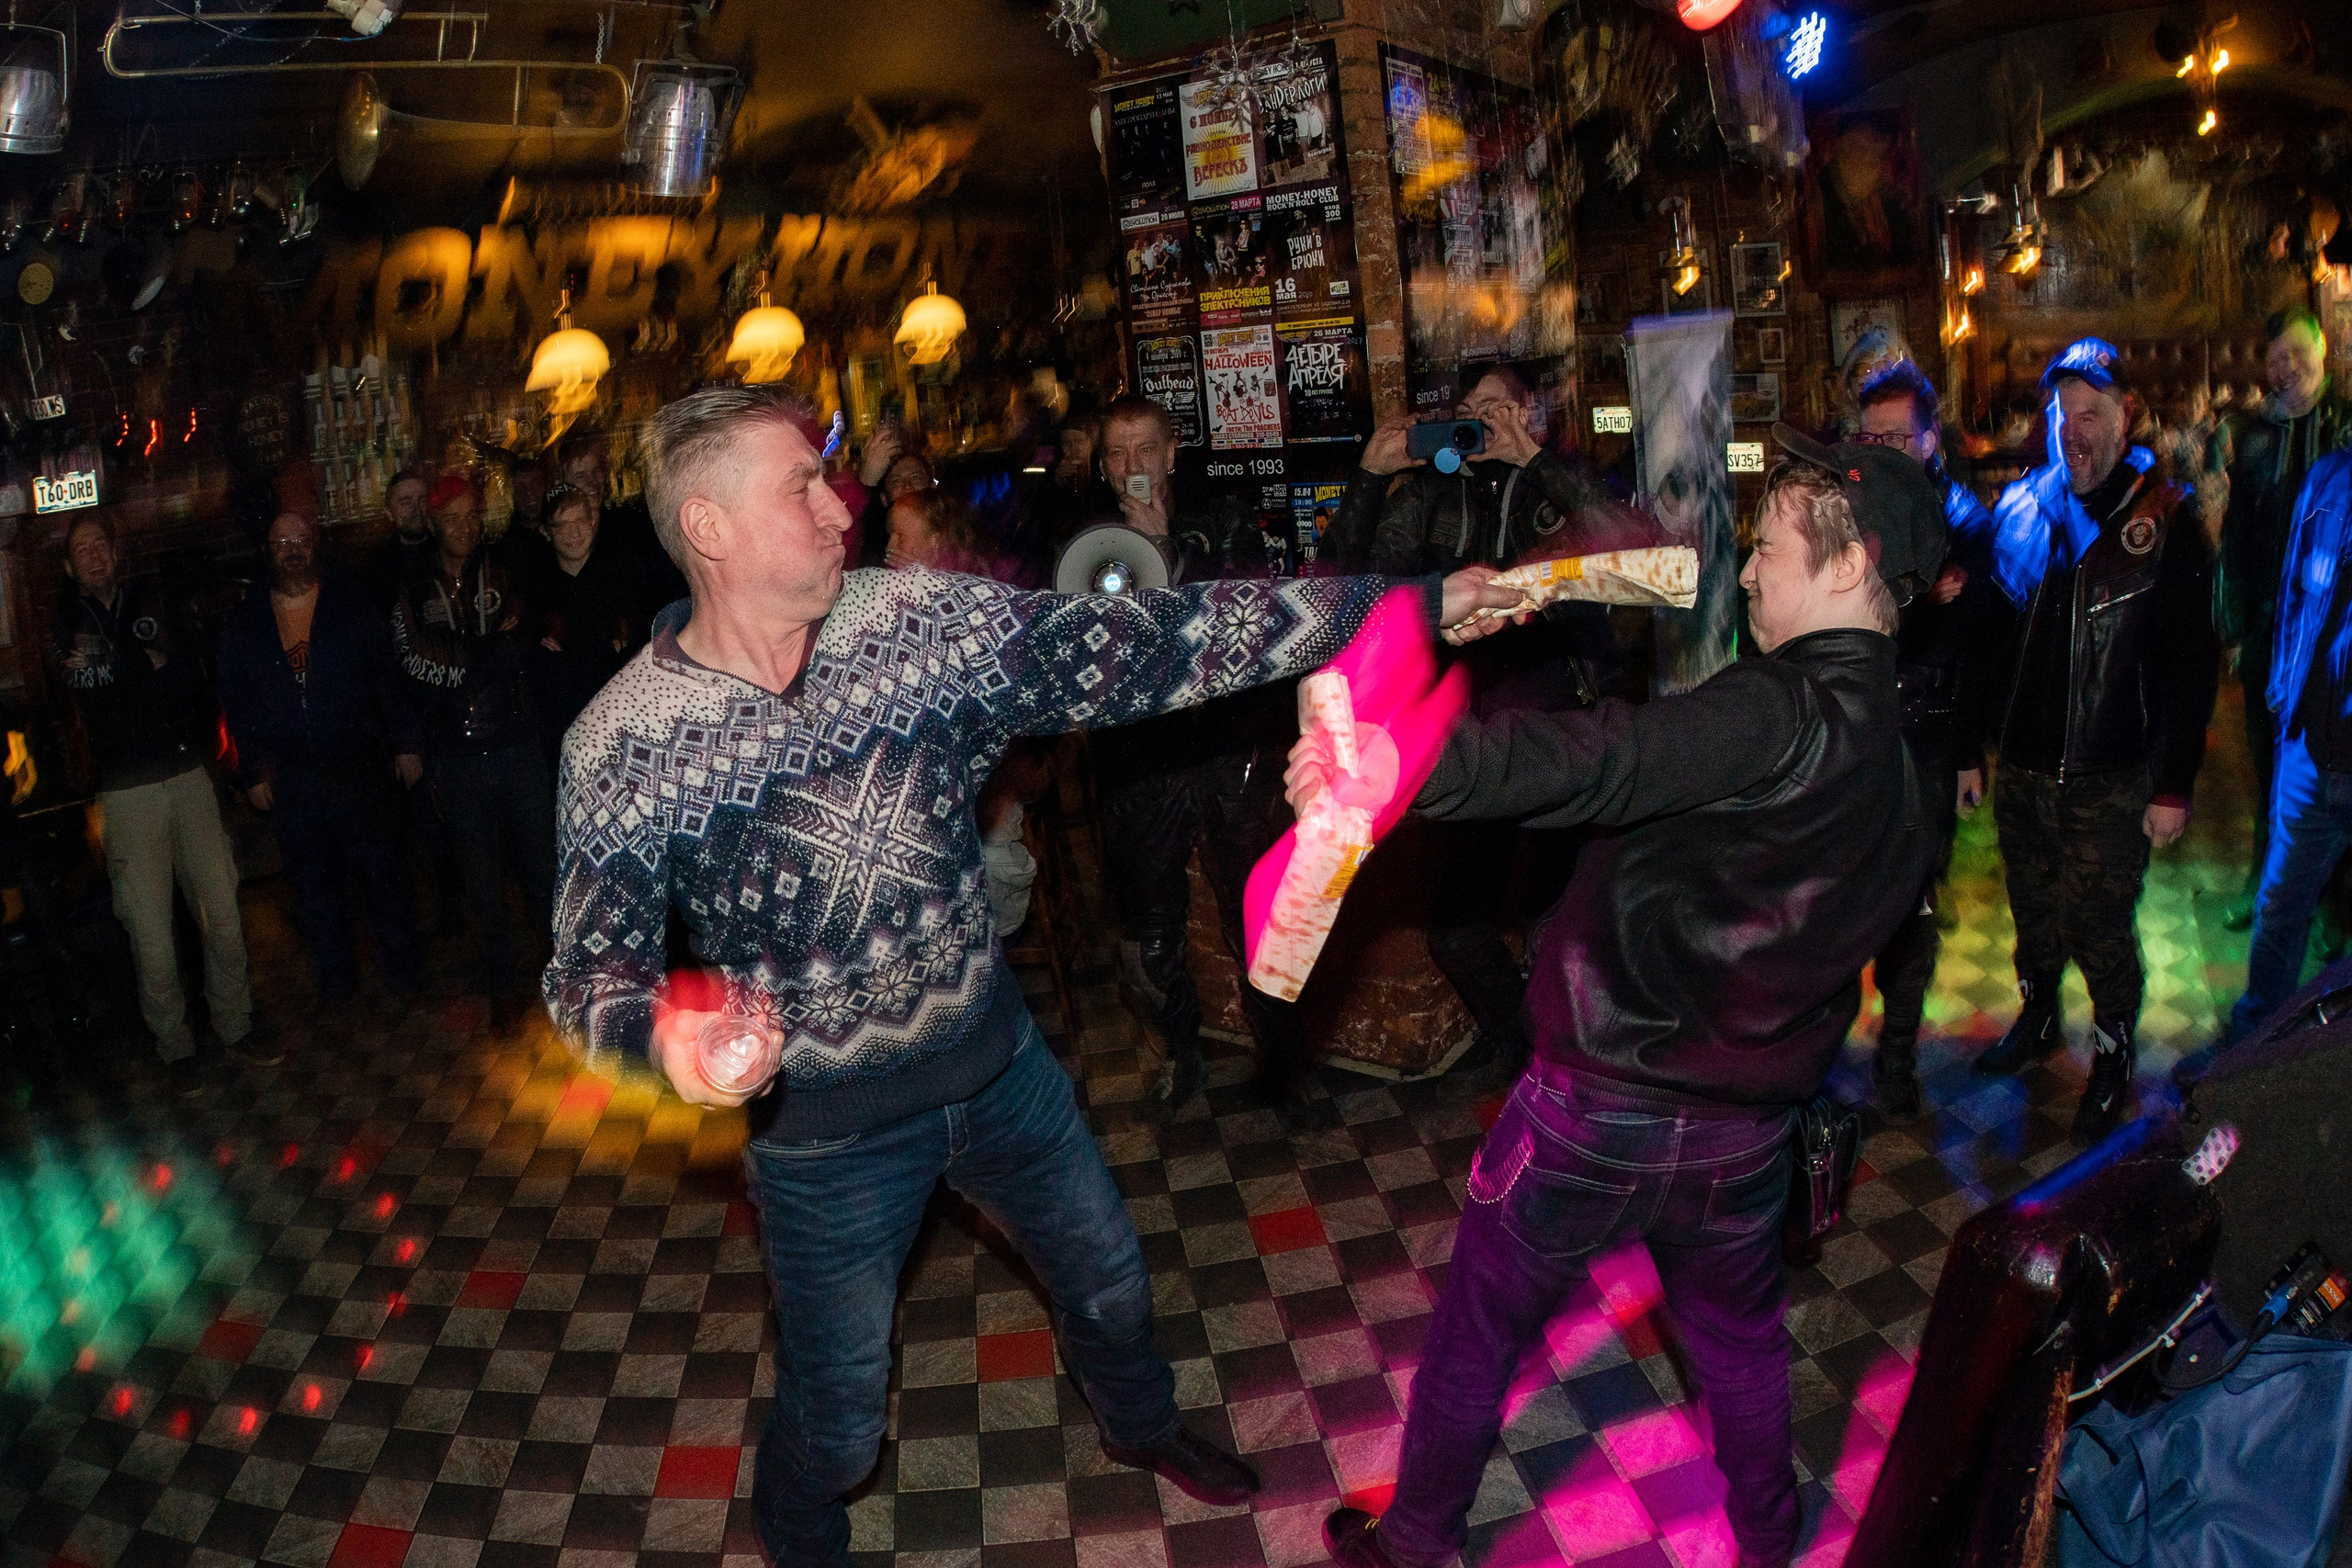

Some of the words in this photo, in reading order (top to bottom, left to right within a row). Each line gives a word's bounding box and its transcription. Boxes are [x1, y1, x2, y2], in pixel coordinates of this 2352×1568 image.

[1231, 201, 1238, 210] 28
[1238, 197, 1261, 209] МАРТА
[1265, 186, 1339, 204] MONEY-HONEY
[1318, 195, 1339, 204] CLUB
[1325, 209, 1340, 218] 300
[1291, 250, 1325, 270] БРЮКИ
[1275, 277, 1296, 293] 16
[1200, 286, 1270, 302] ПРИКЛЮЧЕНИЯ
[1200, 296, 1272, 312] ЭЛЕКТРОНИКОВ
[1204, 353, 1272, 370] HALLOWEEN
[1288, 362, 1348, 395] АПРЕЛЯ
[1416, 388, 1439, 405] since
[1440, 385, 1452, 400] 19
[1206, 461, 1244, 477] since
[1249, 459, 1284, 476] 1993
[1295, 487, 1312, 497] 15.04
[1314, 486, 1342, 503] MONEY
